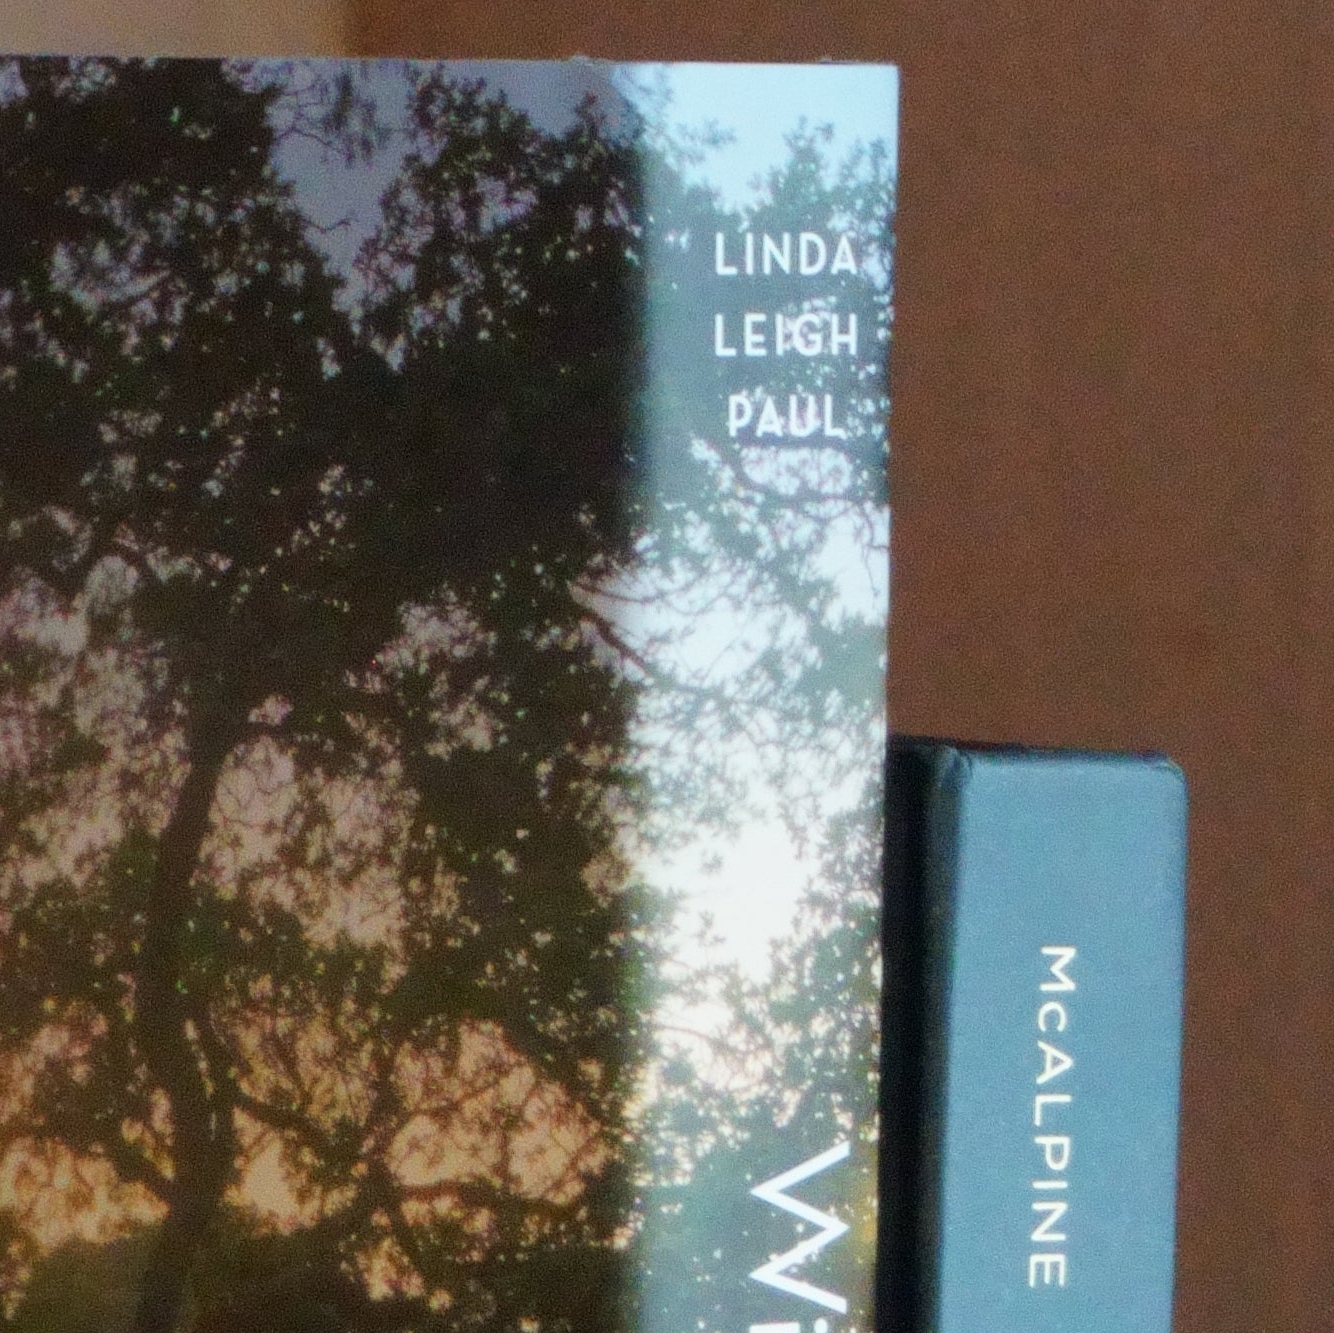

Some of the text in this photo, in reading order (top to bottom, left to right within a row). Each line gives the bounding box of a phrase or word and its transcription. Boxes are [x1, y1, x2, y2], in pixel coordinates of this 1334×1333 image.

[716, 231, 857, 275] LINDA
[715, 311, 857, 356] LEIGH
[728, 392, 846, 438] PAUL
